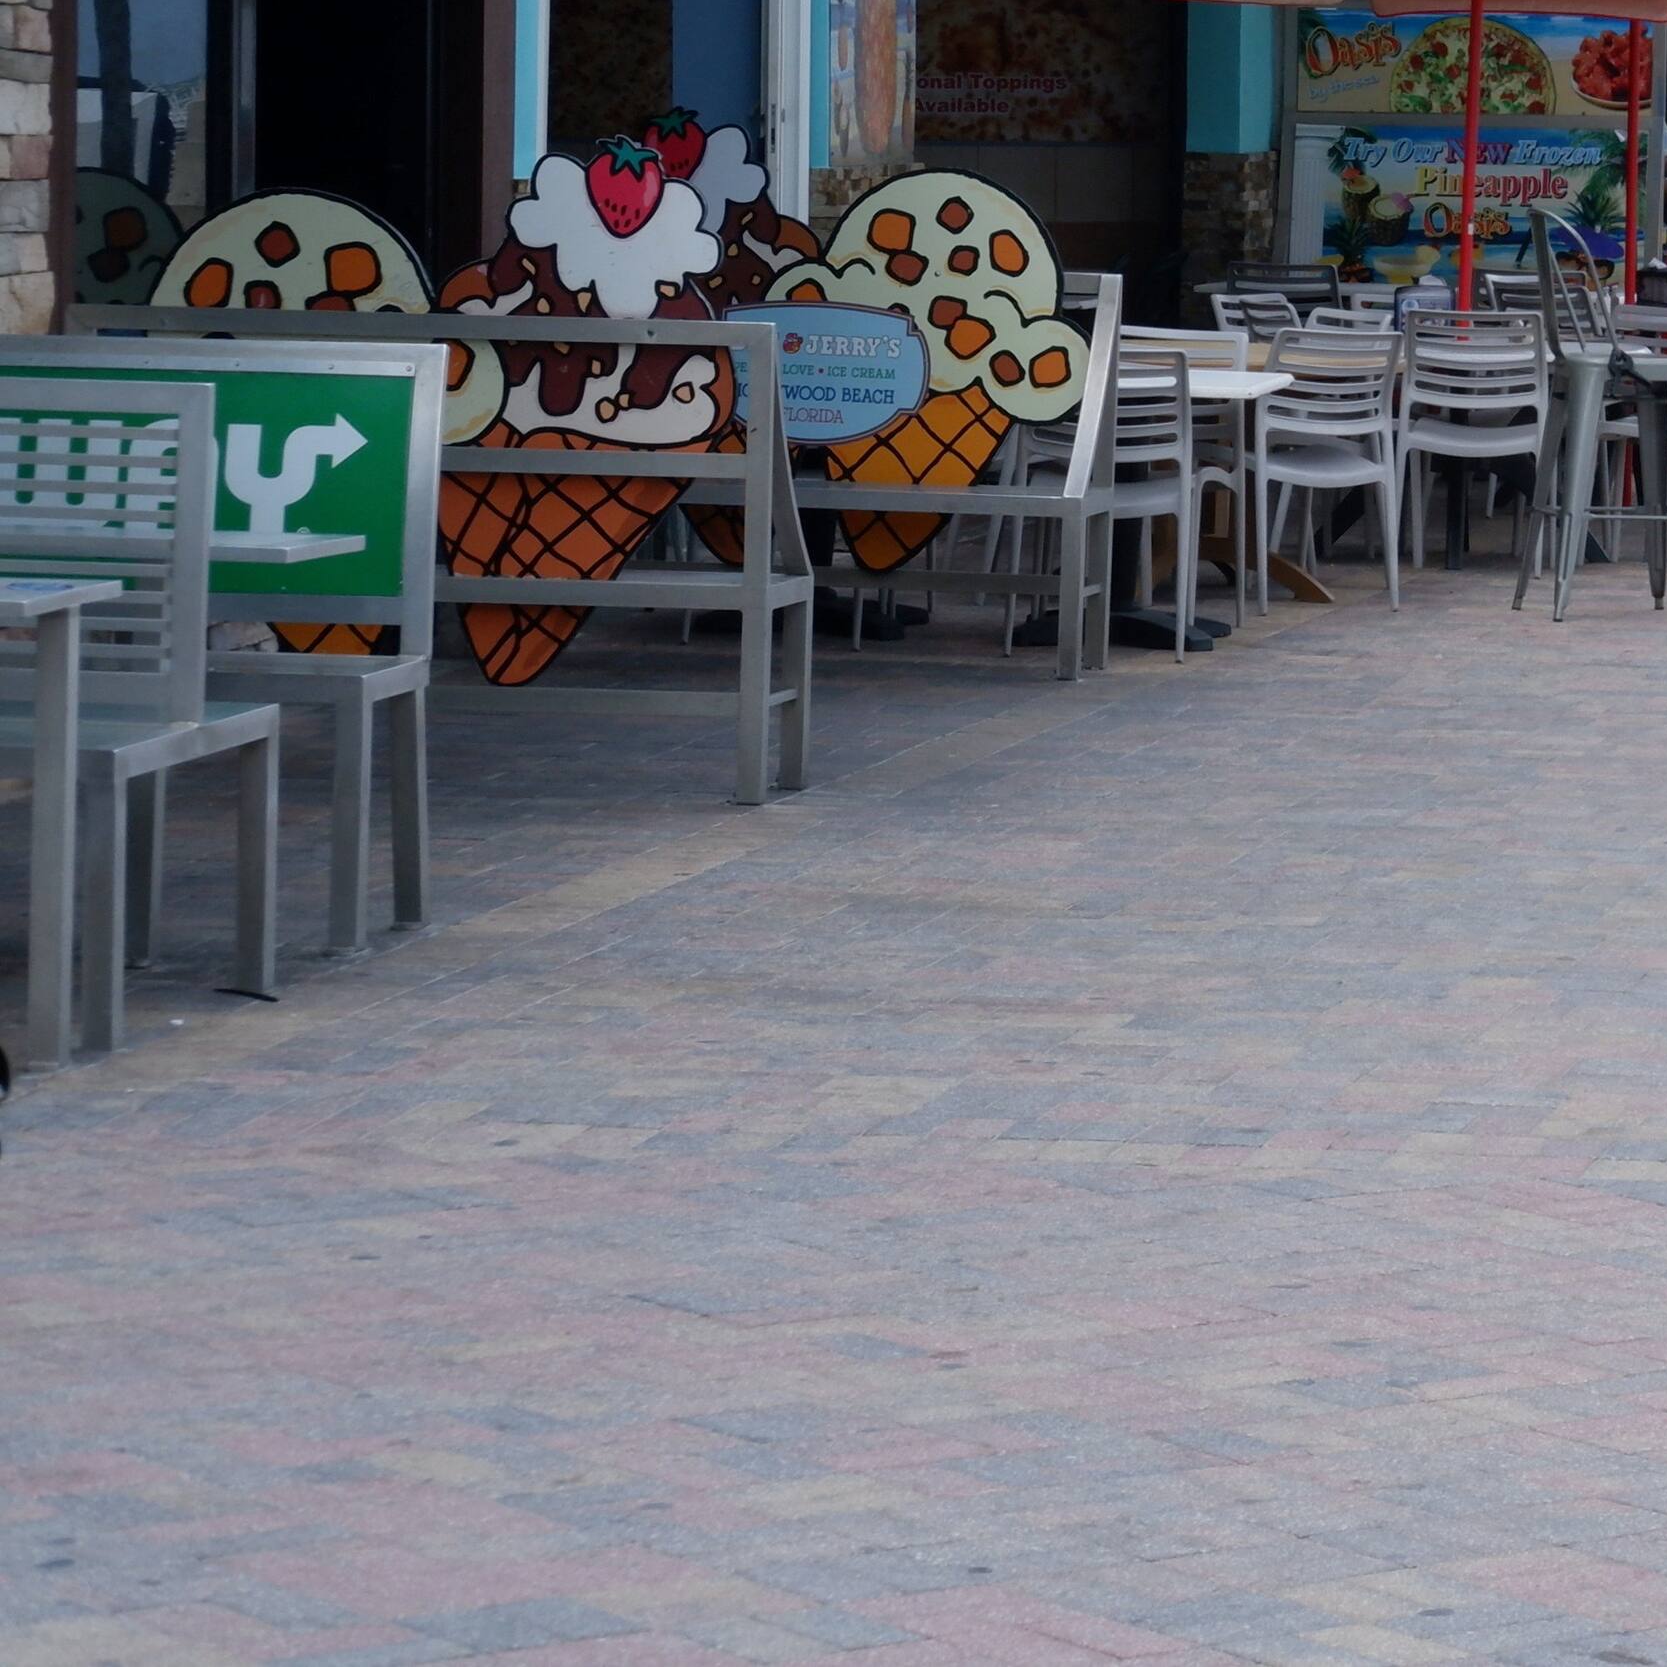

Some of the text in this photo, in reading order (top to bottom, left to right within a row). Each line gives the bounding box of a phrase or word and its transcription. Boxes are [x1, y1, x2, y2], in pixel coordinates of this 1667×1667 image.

[1306, 21, 1402, 79] Oasis
[969, 74, 1068, 93] Toppings
[1343, 137, 1387, 168] Try
[1391, 137, 1444, 165] Our
[1514, 139, 1602, 167] Frozen
[806, 334, 902, 359] JERRY'S
[783, 363, 896, 380] LOVE ICE CREAM
[841, 388, 895, 405] BEACH
